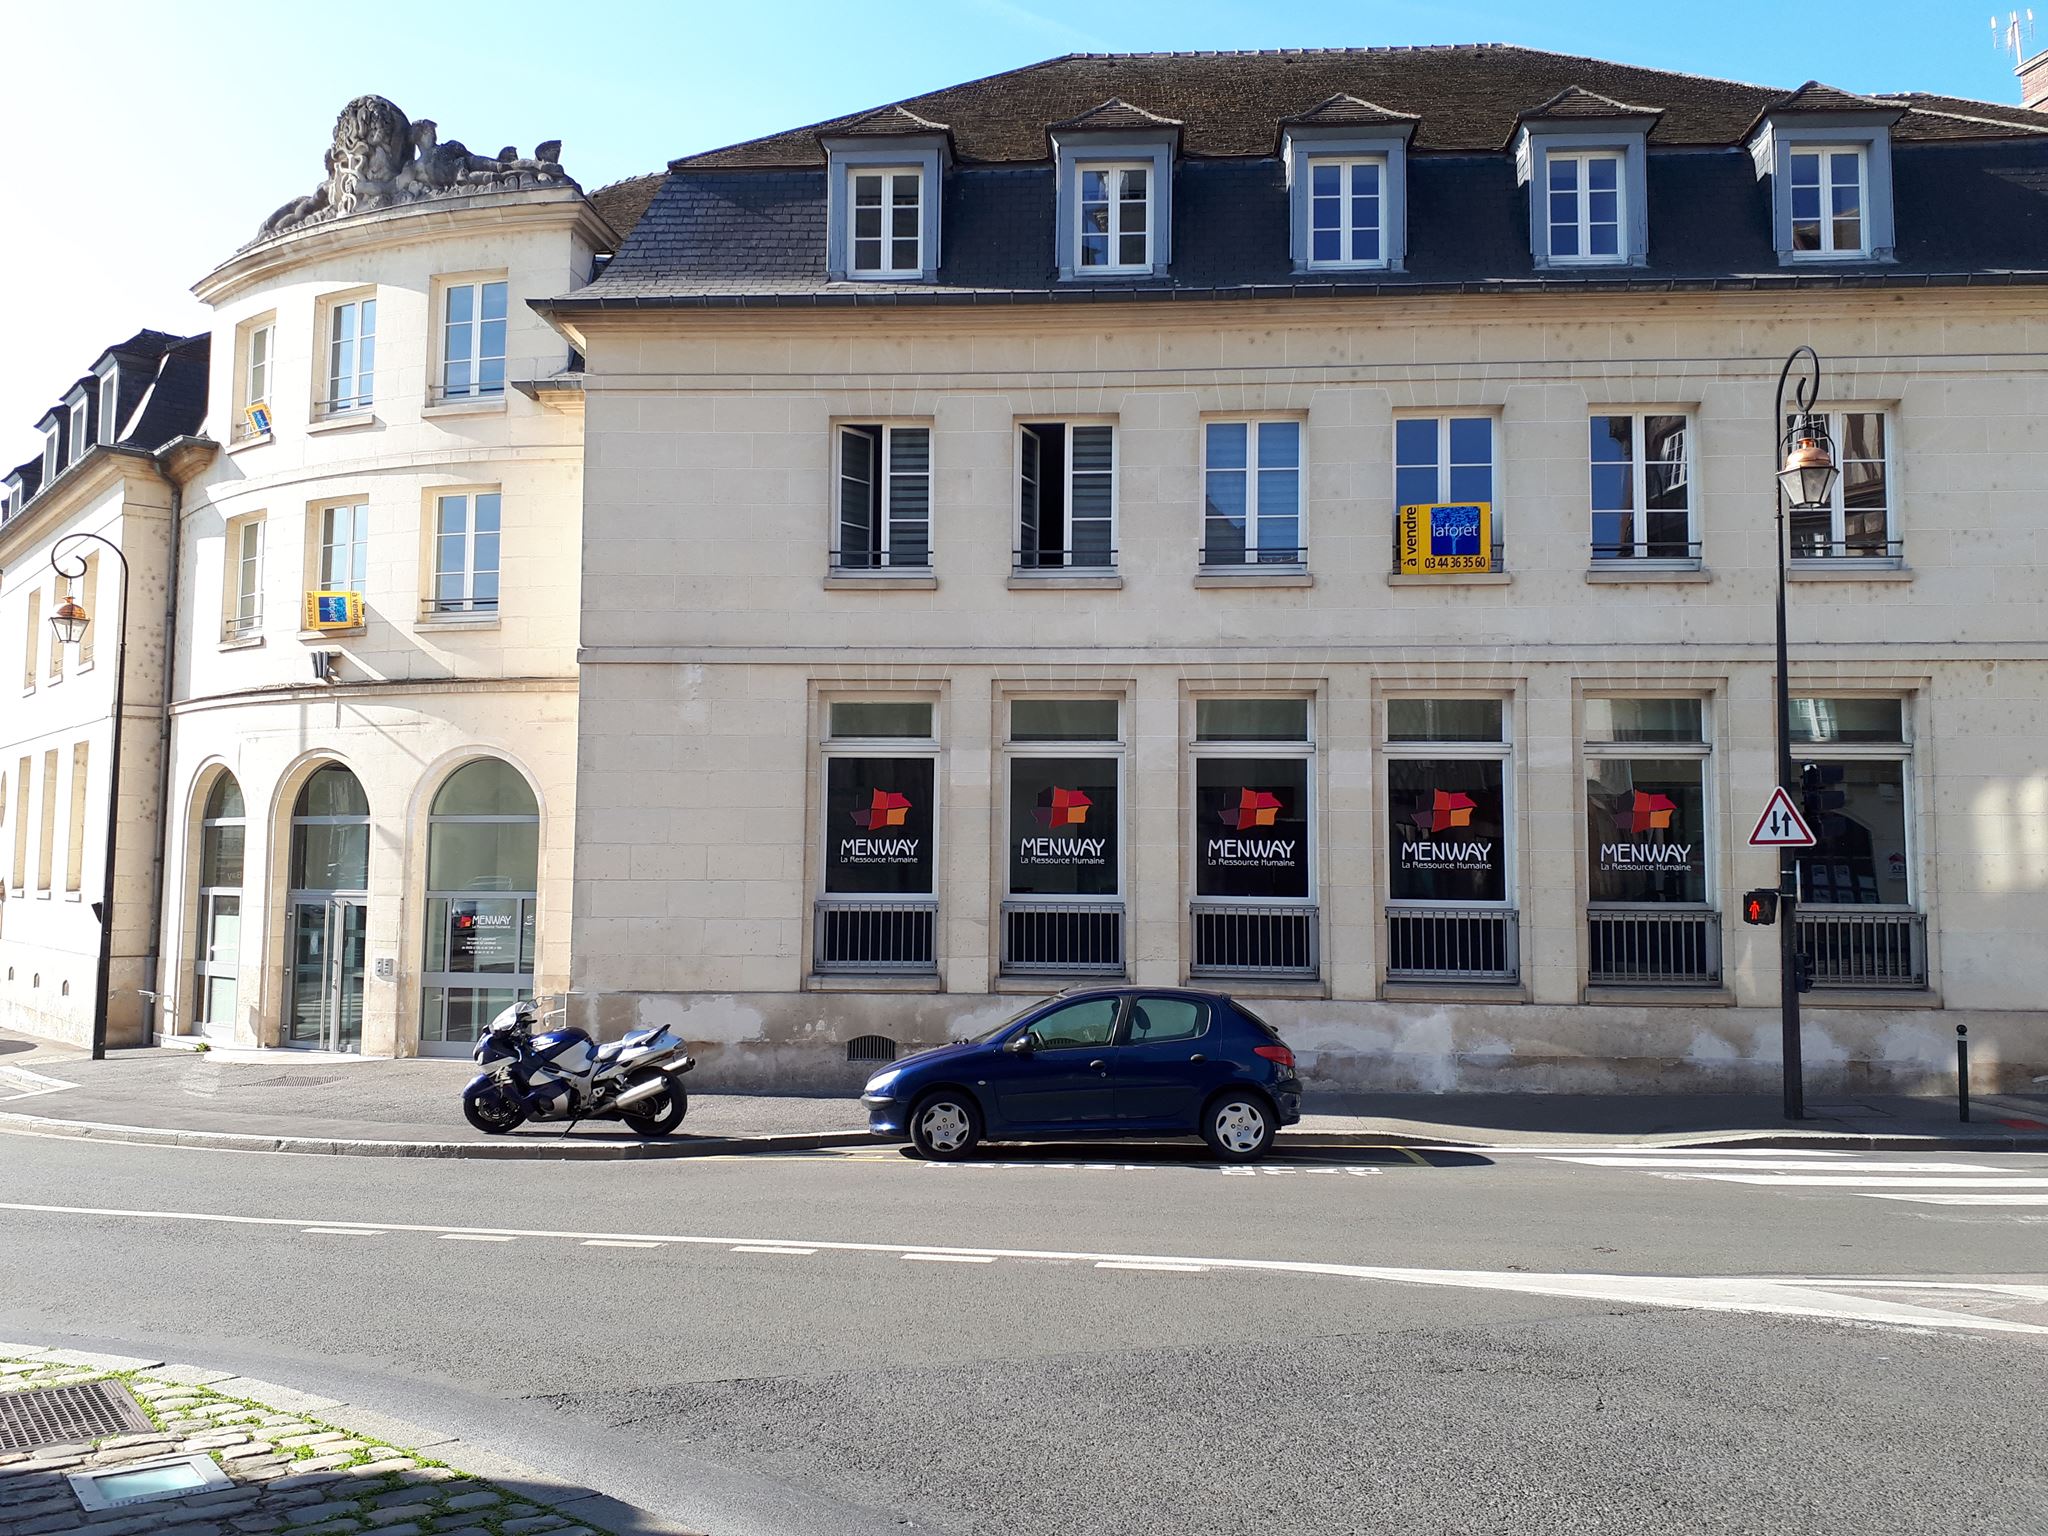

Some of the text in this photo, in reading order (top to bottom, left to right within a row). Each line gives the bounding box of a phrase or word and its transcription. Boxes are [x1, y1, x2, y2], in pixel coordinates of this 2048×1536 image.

[1403, 507, 1417, 567] à vendre
[1432, 523, 1478, 537] laforêt
[1424, 556, 1486, 569] 03 44 36 35 60
[352, 599, 361, 626] vendre
[841, 838, 919, 855] MENWAY
[1021, 838, 1105, 856] MENWAY
[1208, 839, 1295, 858] MENWAY
[1402, 842, 1492, 861] MENWAY
[1601, 843, 1691, 862] MENWAY
[1218, 858, 1259, 866] Ressource
[1401, 861, 1410, 869] La
[1412, 861, 1455, 869] Ressource
[1600, 863, 1692, 871] La Ressource Humaine
[472, 915, 512, 925] MENWAY
